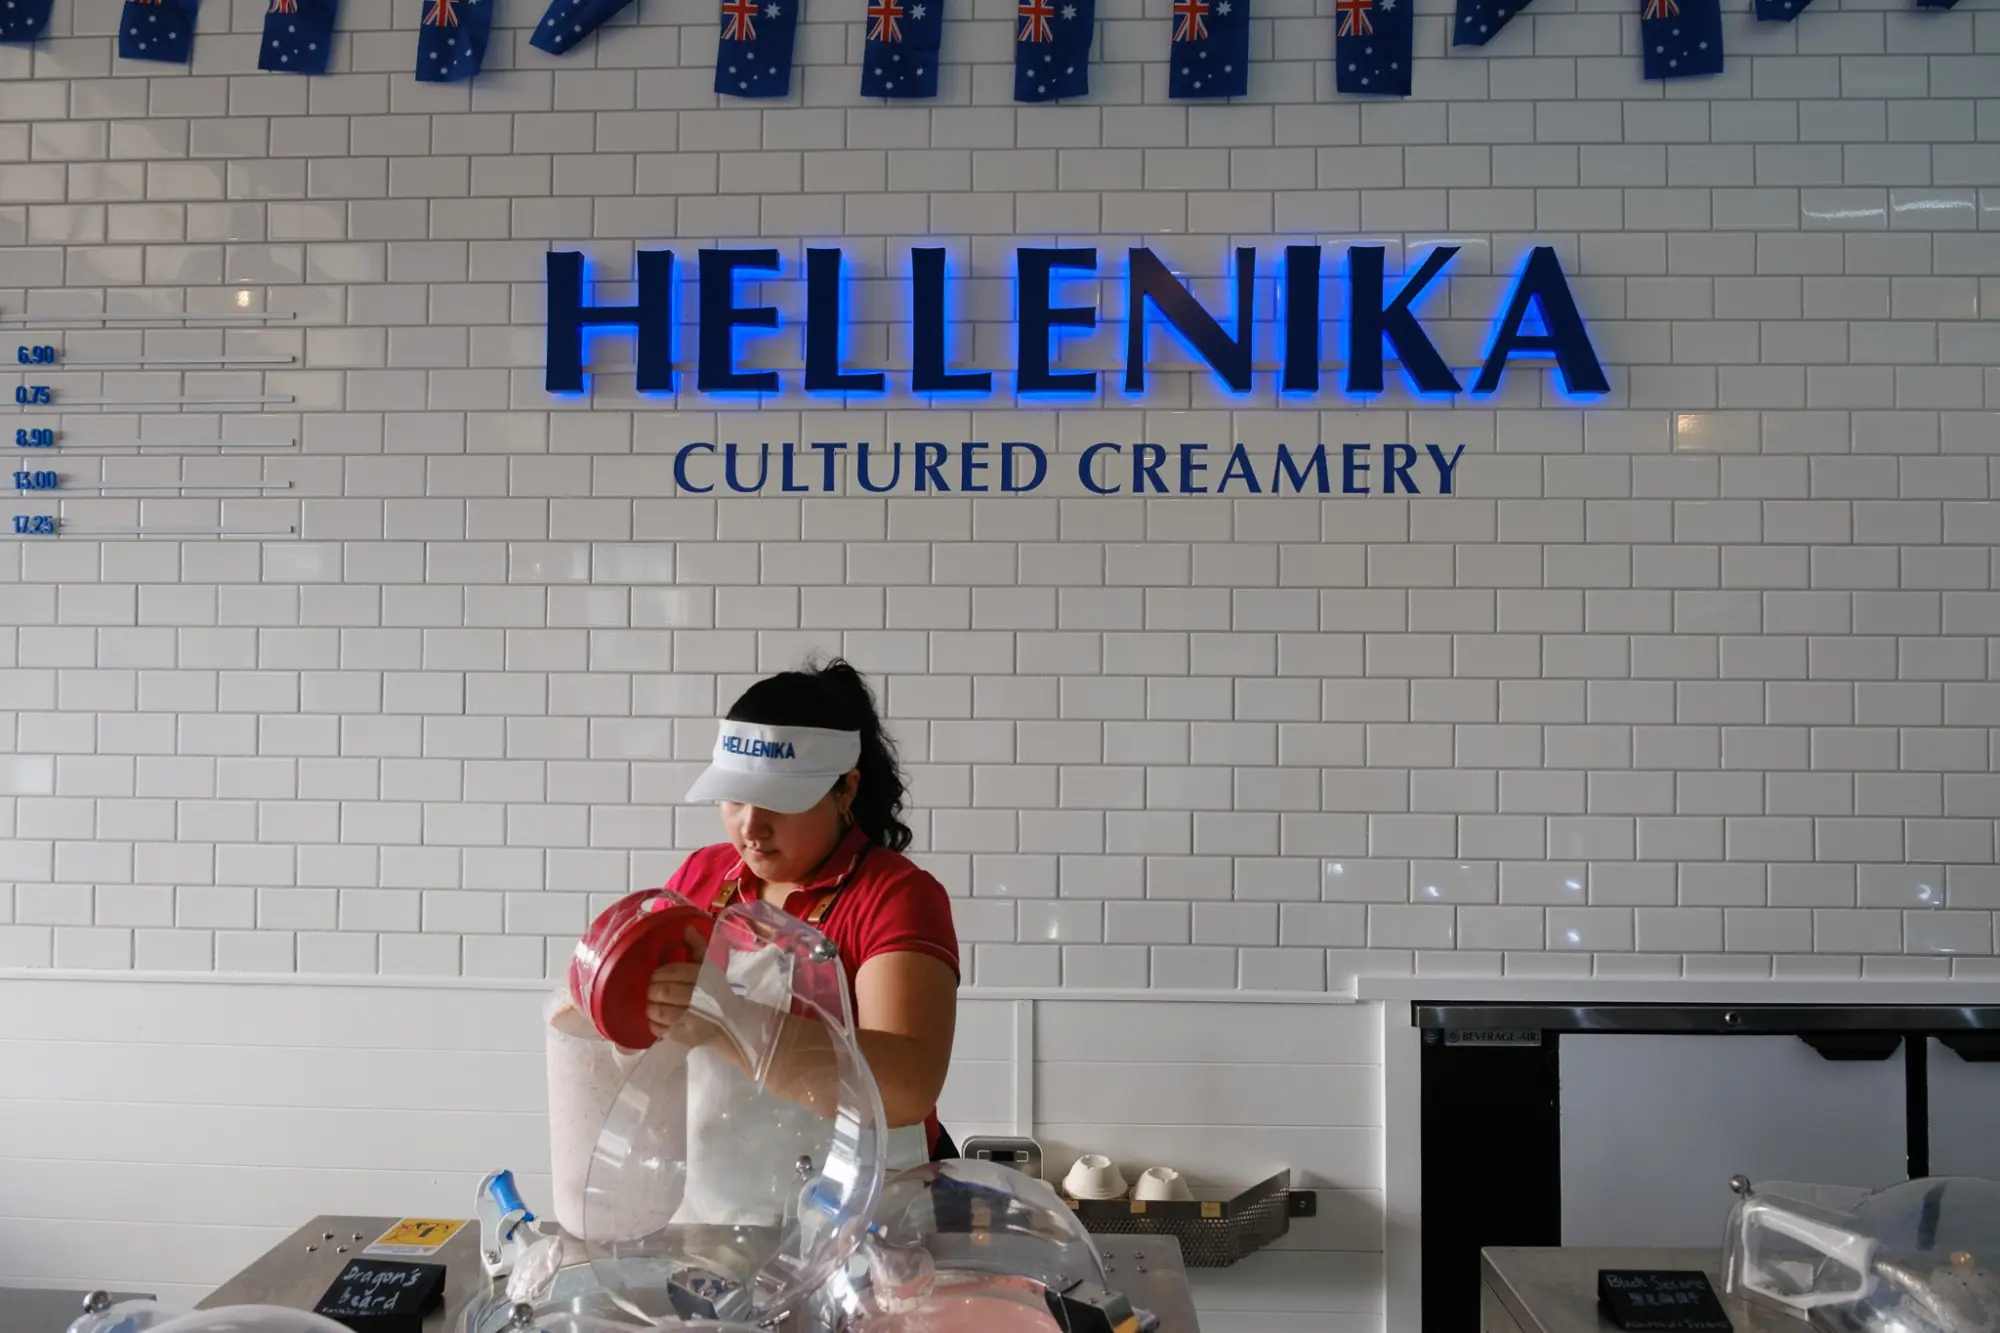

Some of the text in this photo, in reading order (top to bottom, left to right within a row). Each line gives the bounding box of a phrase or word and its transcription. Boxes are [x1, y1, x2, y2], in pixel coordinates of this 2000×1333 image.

[545, 246, 1612, 393] HELLENIKA
[17, 345, 55, 364] 6.90
[15, 386, 51, 405] 0.75
[15, 429, 53, 447] 8.90
[673, 442, 1466, 494] CULTURED CREAMERY
[12, 516, 54, 535] 17.25
[722, 735, 796, 759] HELLENIKA
[343, 1265, 422, 1295] Dragon's
